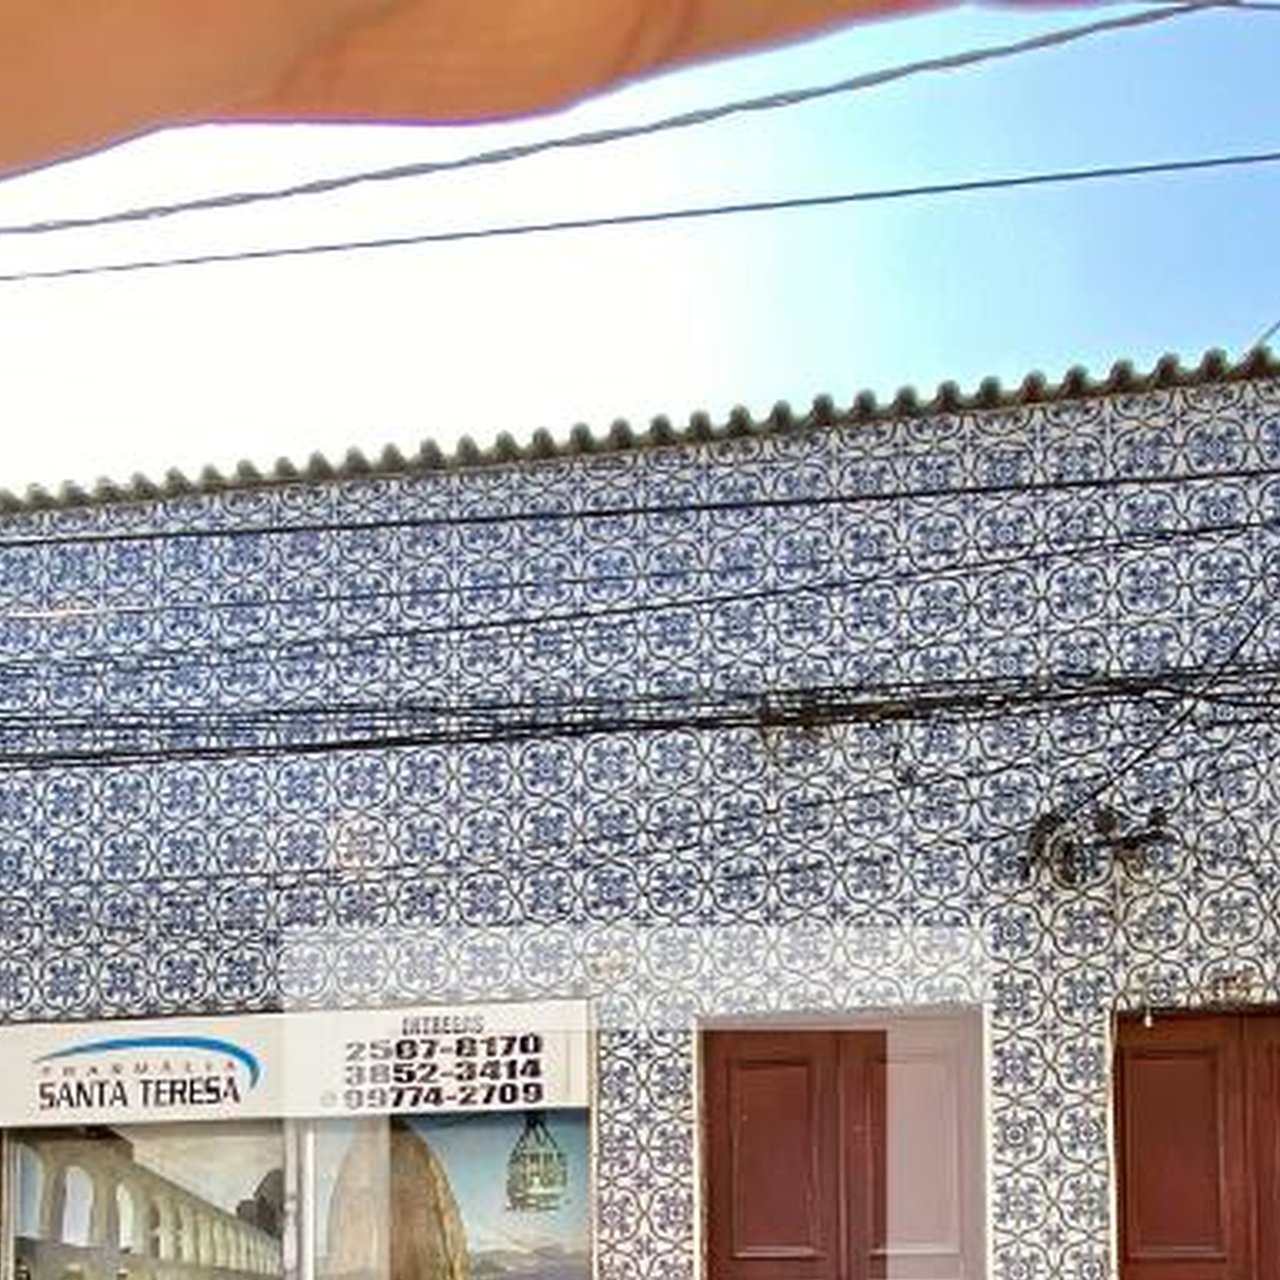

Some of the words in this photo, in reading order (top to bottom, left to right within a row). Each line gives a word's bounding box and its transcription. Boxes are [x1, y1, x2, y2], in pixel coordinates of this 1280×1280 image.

[345, 1058, 542, 1086] 3852-3414
[39, 1080, 129, 1110] SANTA
[139, 1075, 241, 1107] TERESA
